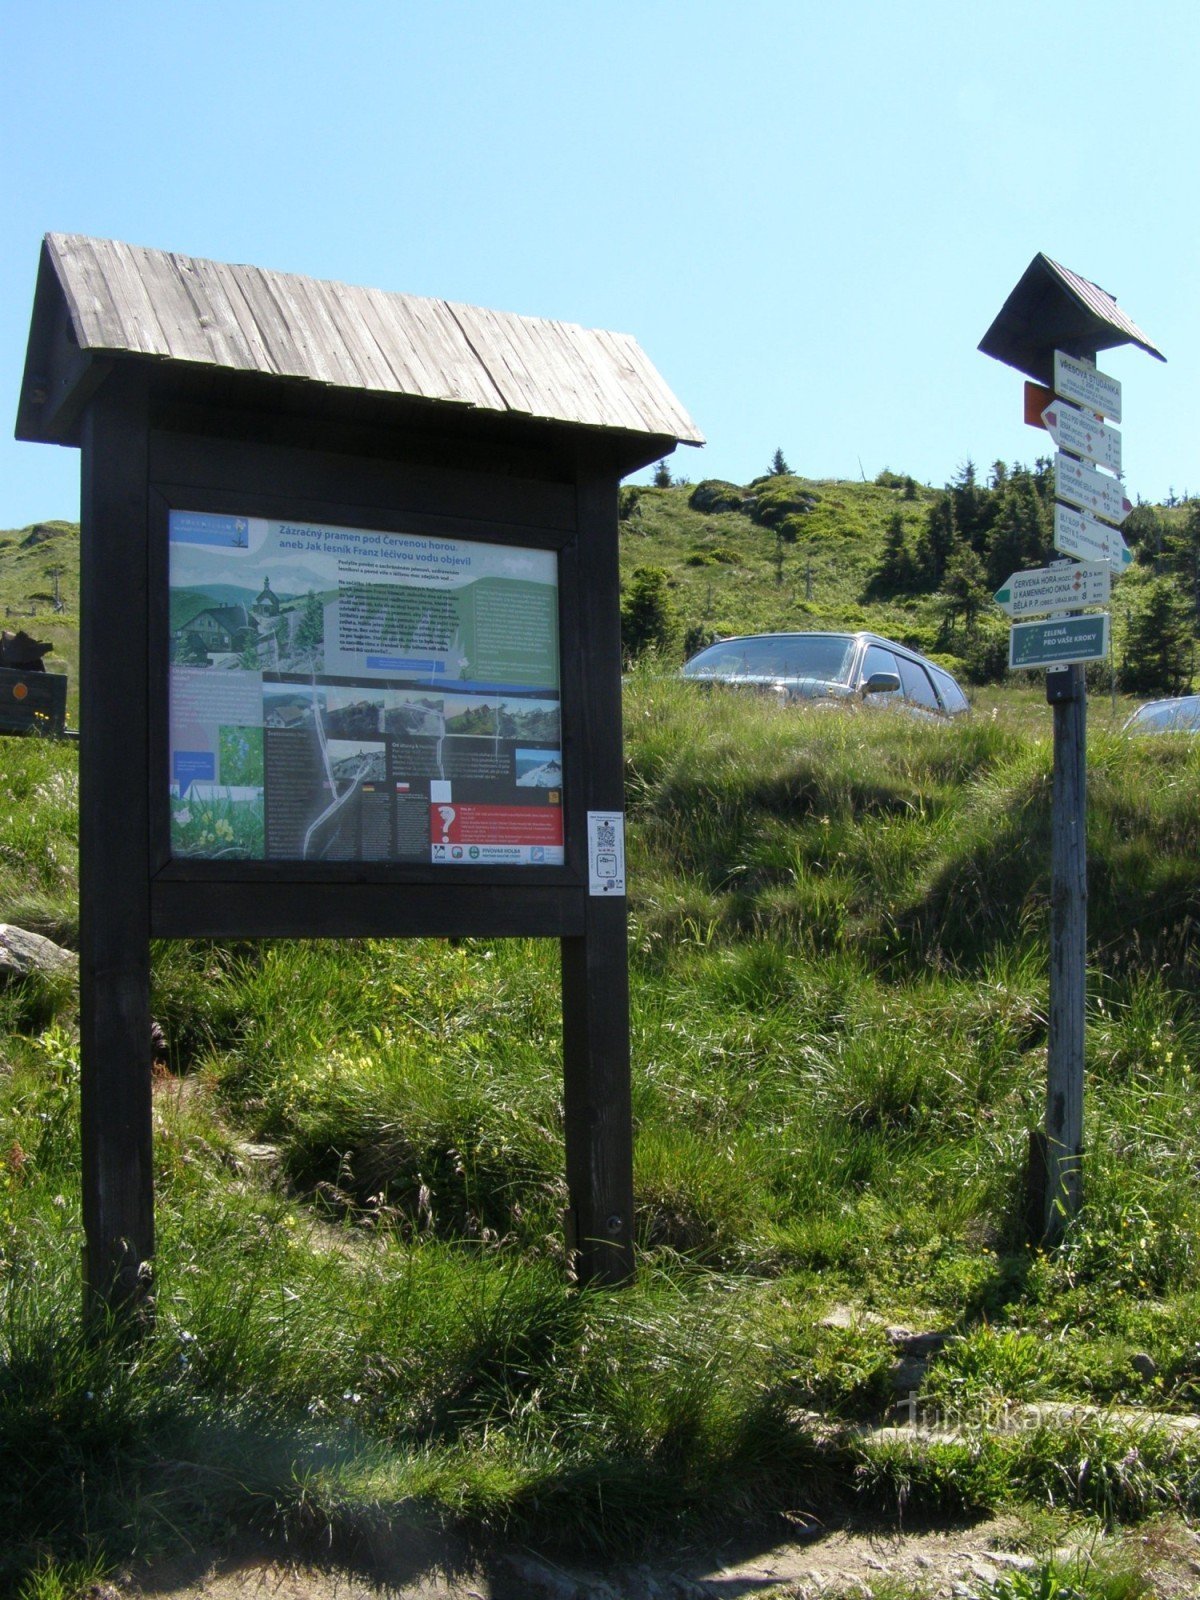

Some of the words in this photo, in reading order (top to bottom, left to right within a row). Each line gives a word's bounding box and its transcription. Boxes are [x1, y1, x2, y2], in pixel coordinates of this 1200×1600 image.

[279, 525, 323, 540] Zázračný
[324, 529, 361, 543] pramen
[362, 533, 381, 546] pod
[383, 533, 427, 549] Červenou
[279, 539, 303, 550] aneb
[305, 541, 322, 552] Jak
[323, 543, 351, 555] lesník
[353, 546, 379, 558] Franz
[381, 548, 414, 562] léčivou
[416, 552, 439, 564] vodu
[440, 555, 472, 568] objevil
[1014, 576, 1040, 589] ČERVENÁ
[1041, 575, 1057, 584] HORA
[1054, 584, 1070, 593] OKNA
[1043, 627, 1067, 638] ZELENÁ
[1043, 638, 1056, 646] PRO
[1057, 636, 1073, 645] VAŠE
[1074, 633, 1097, 643] KROKY
